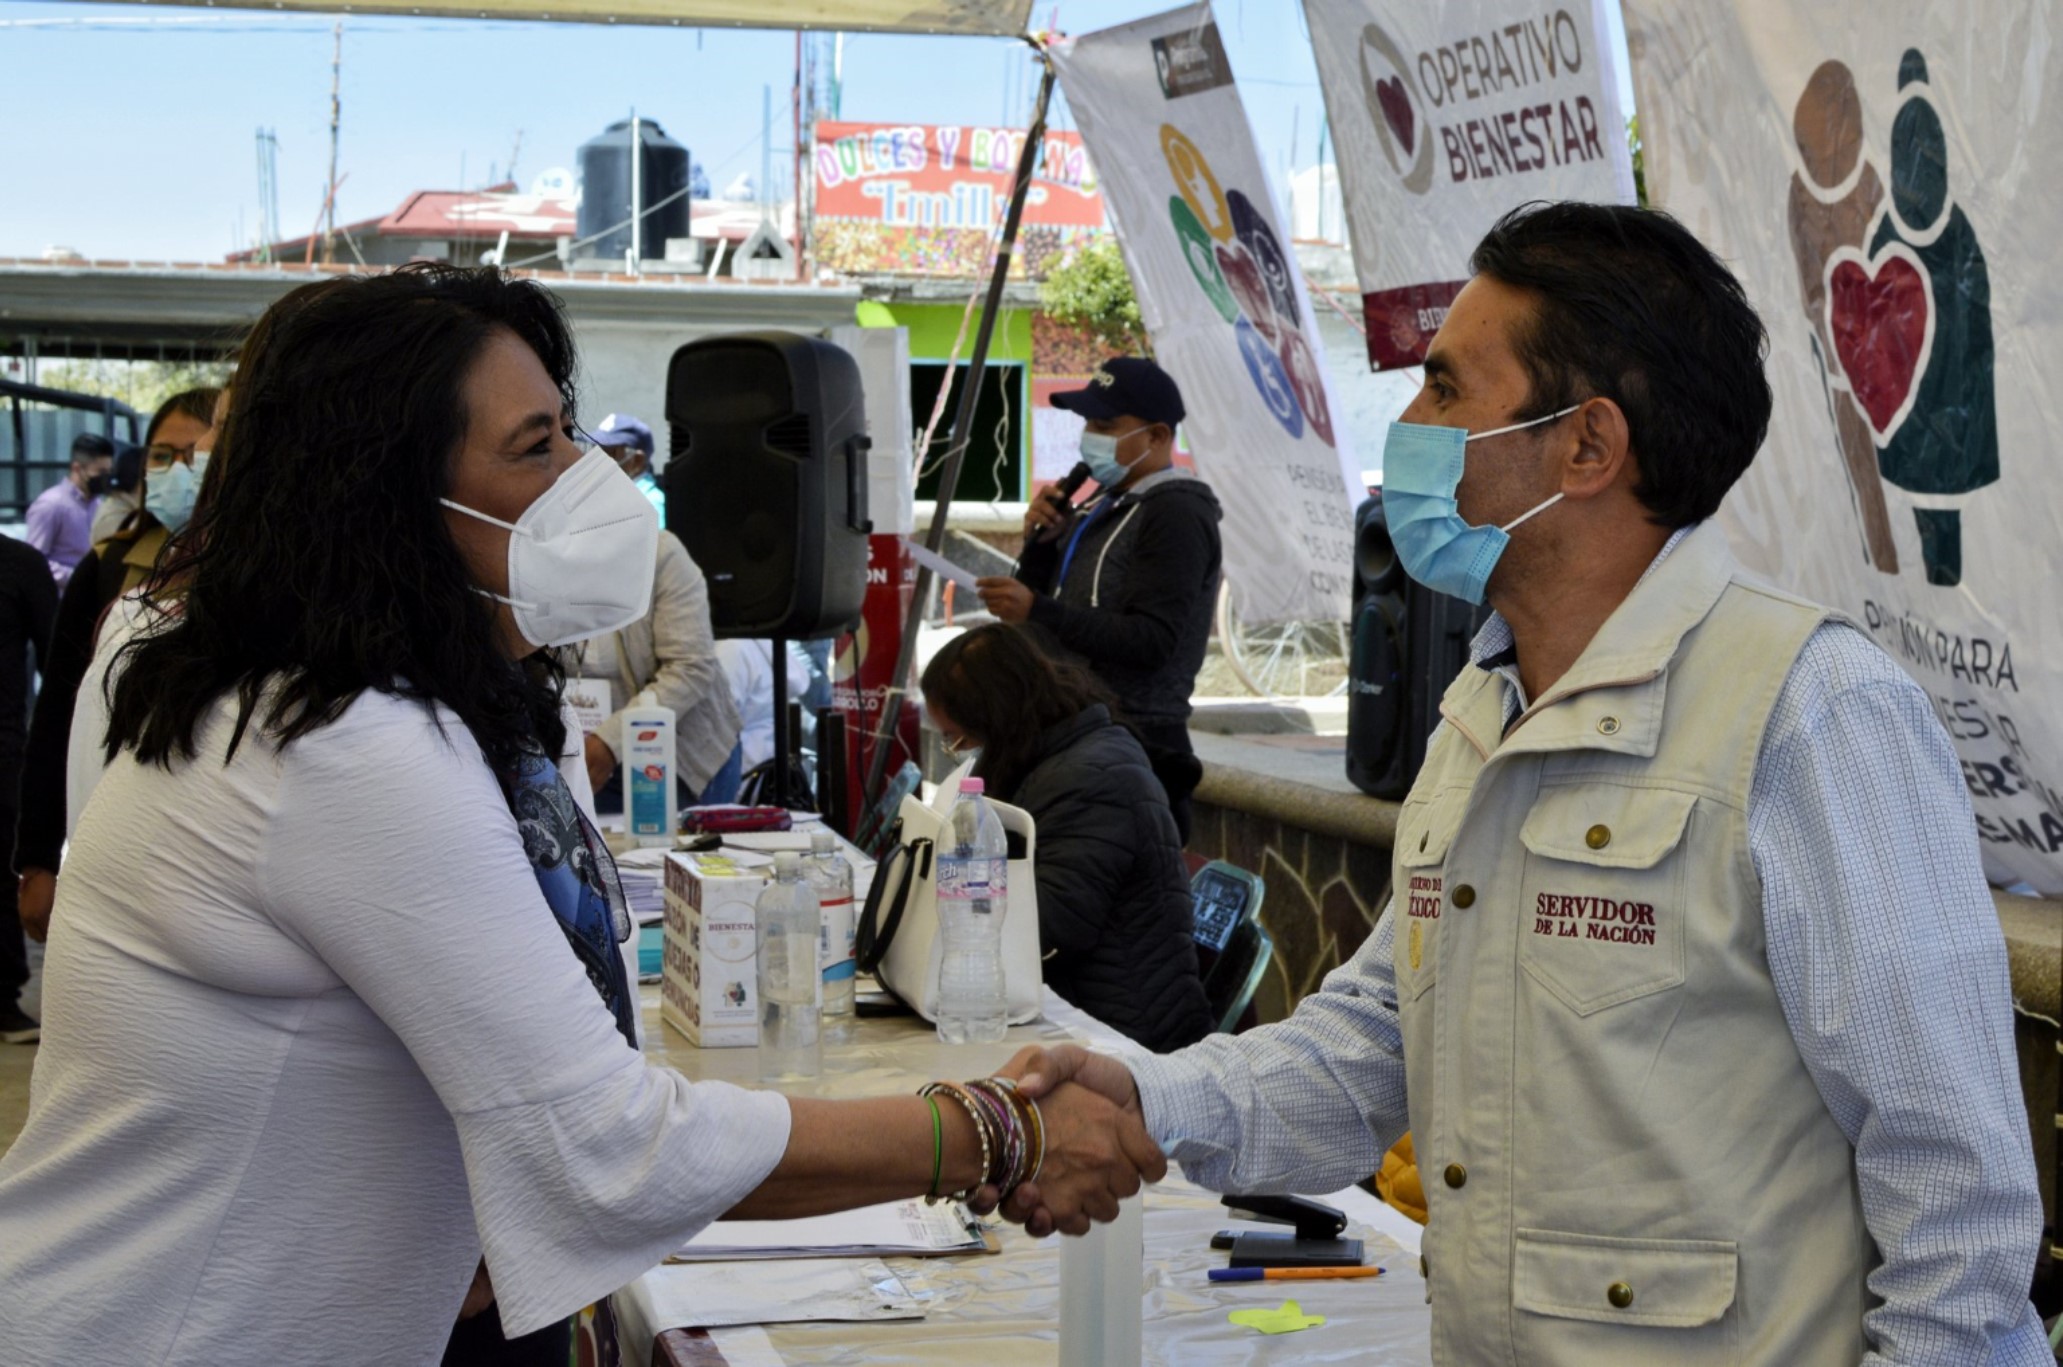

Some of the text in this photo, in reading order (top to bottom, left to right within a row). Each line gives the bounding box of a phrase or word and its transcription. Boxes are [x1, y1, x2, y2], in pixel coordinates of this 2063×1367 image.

[1418, 9, 1582, 108] OPERATIVO
[816, 128, 926, 188] DULCES
[936, 126, 961, 171] Y
[1440, 95, 1604, 183] BIENESTAR
[1936, 629, 2019, 693] PARA
[708, 922, 758, 933] BIENESTA
[1408, 889, 1441, 919] ÉXICO
[1536, 892, 1656, 927] SERVIDOR
[1533, 918, 1656, 946] DE LA NACIÓN
